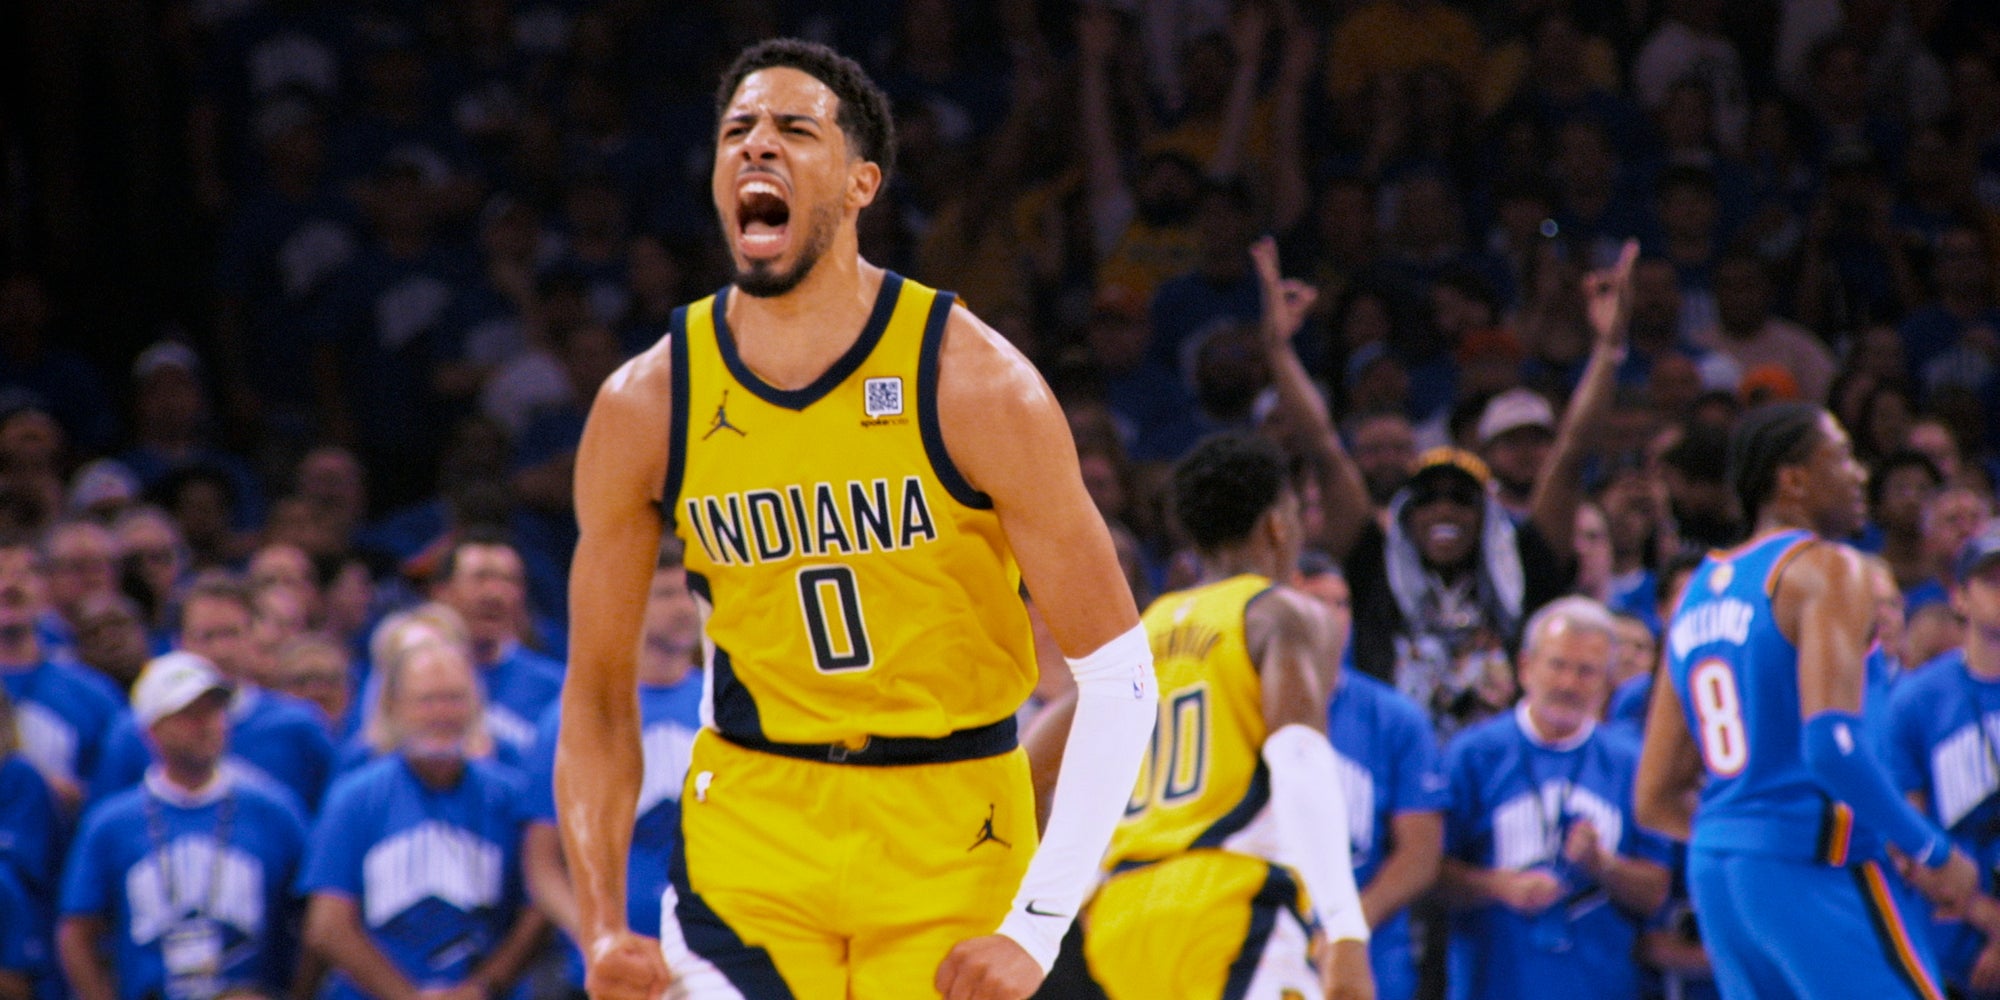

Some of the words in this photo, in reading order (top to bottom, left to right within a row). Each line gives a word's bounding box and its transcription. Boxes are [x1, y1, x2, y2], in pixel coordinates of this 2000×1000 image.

[685, 475, 938, 566] INDIANA
[796, 562, 874, 675] 0
[1689, 657, 1750, 779] 8
